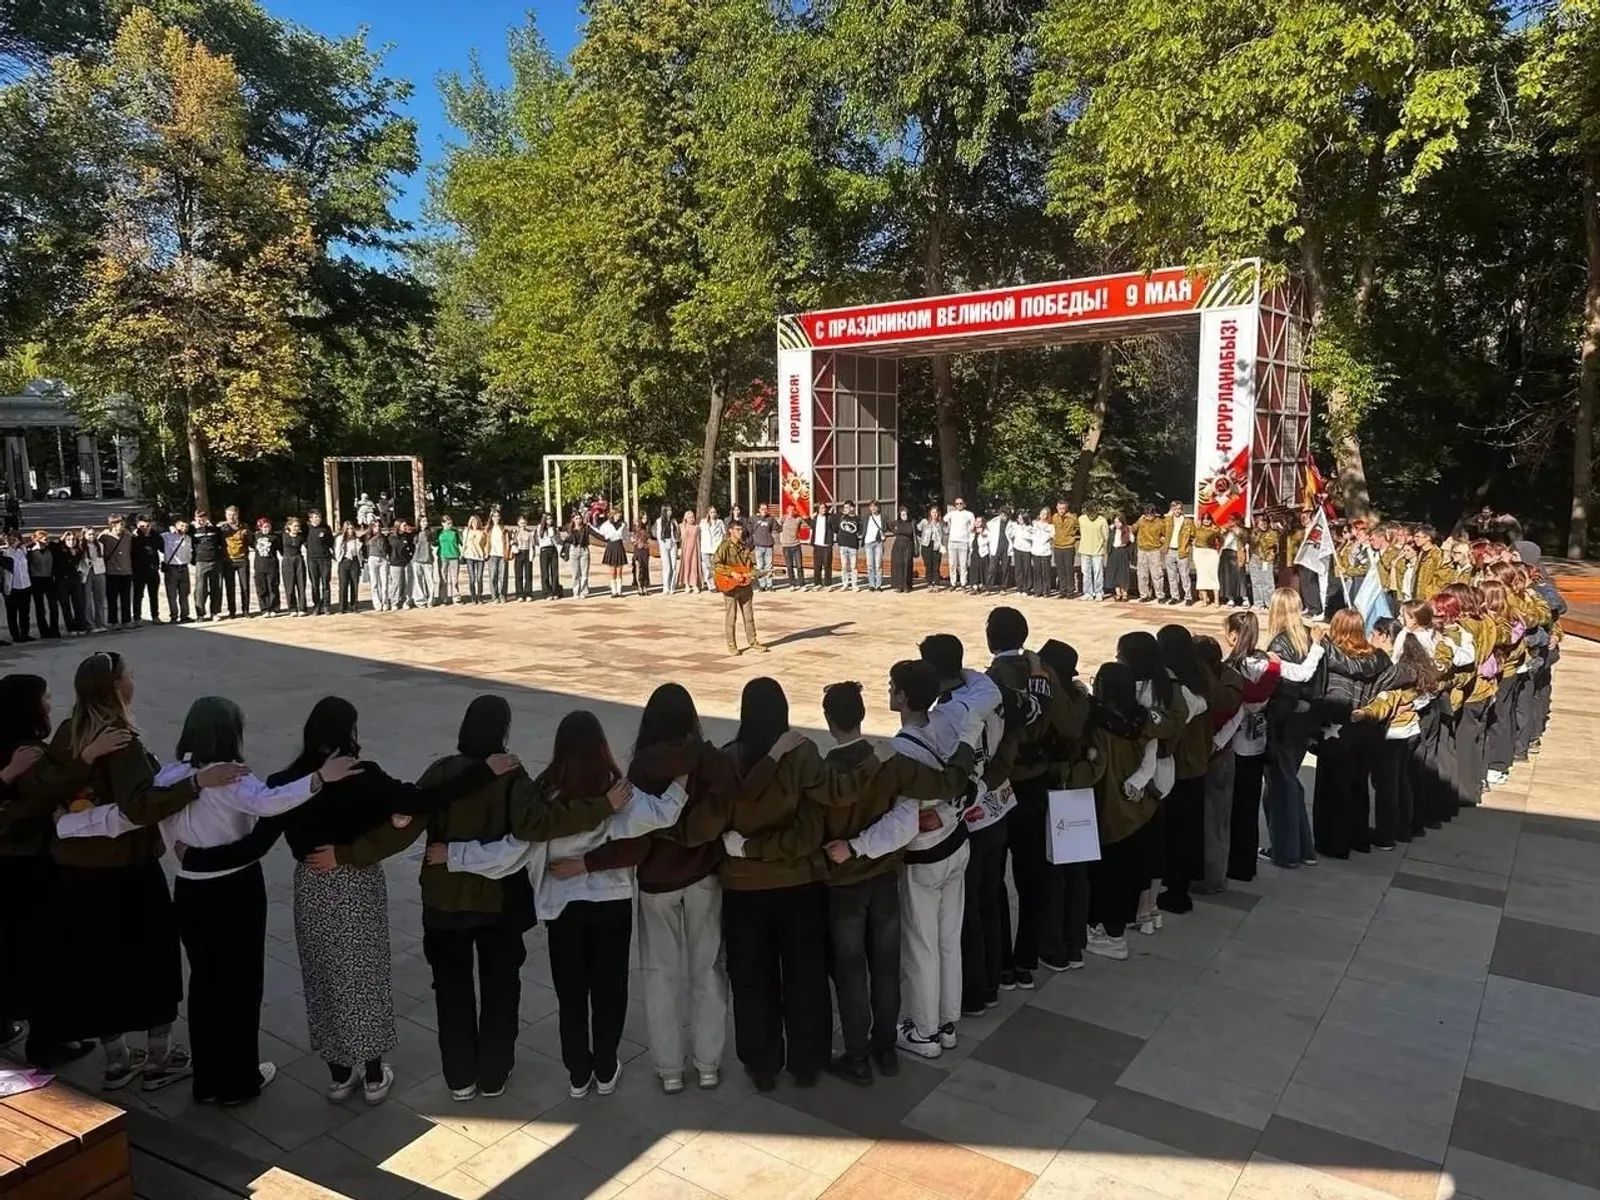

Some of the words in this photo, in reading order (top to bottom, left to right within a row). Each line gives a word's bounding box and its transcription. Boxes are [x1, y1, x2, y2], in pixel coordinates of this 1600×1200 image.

[815, 320, 825, 340] С
[828, 308, 933, 338] ПРАЗДНИКОМ
[937, 296, 1016, 328] ВЕЛИКОЙ
[1020, 287, 1109, 318] ПОБЕДЫ!
[1125, 284, 1139, 308] 9
[1144, 279, 1193, 305] МАЯ
[790, 374, 801, 444] ГОРДИМСЯ!
